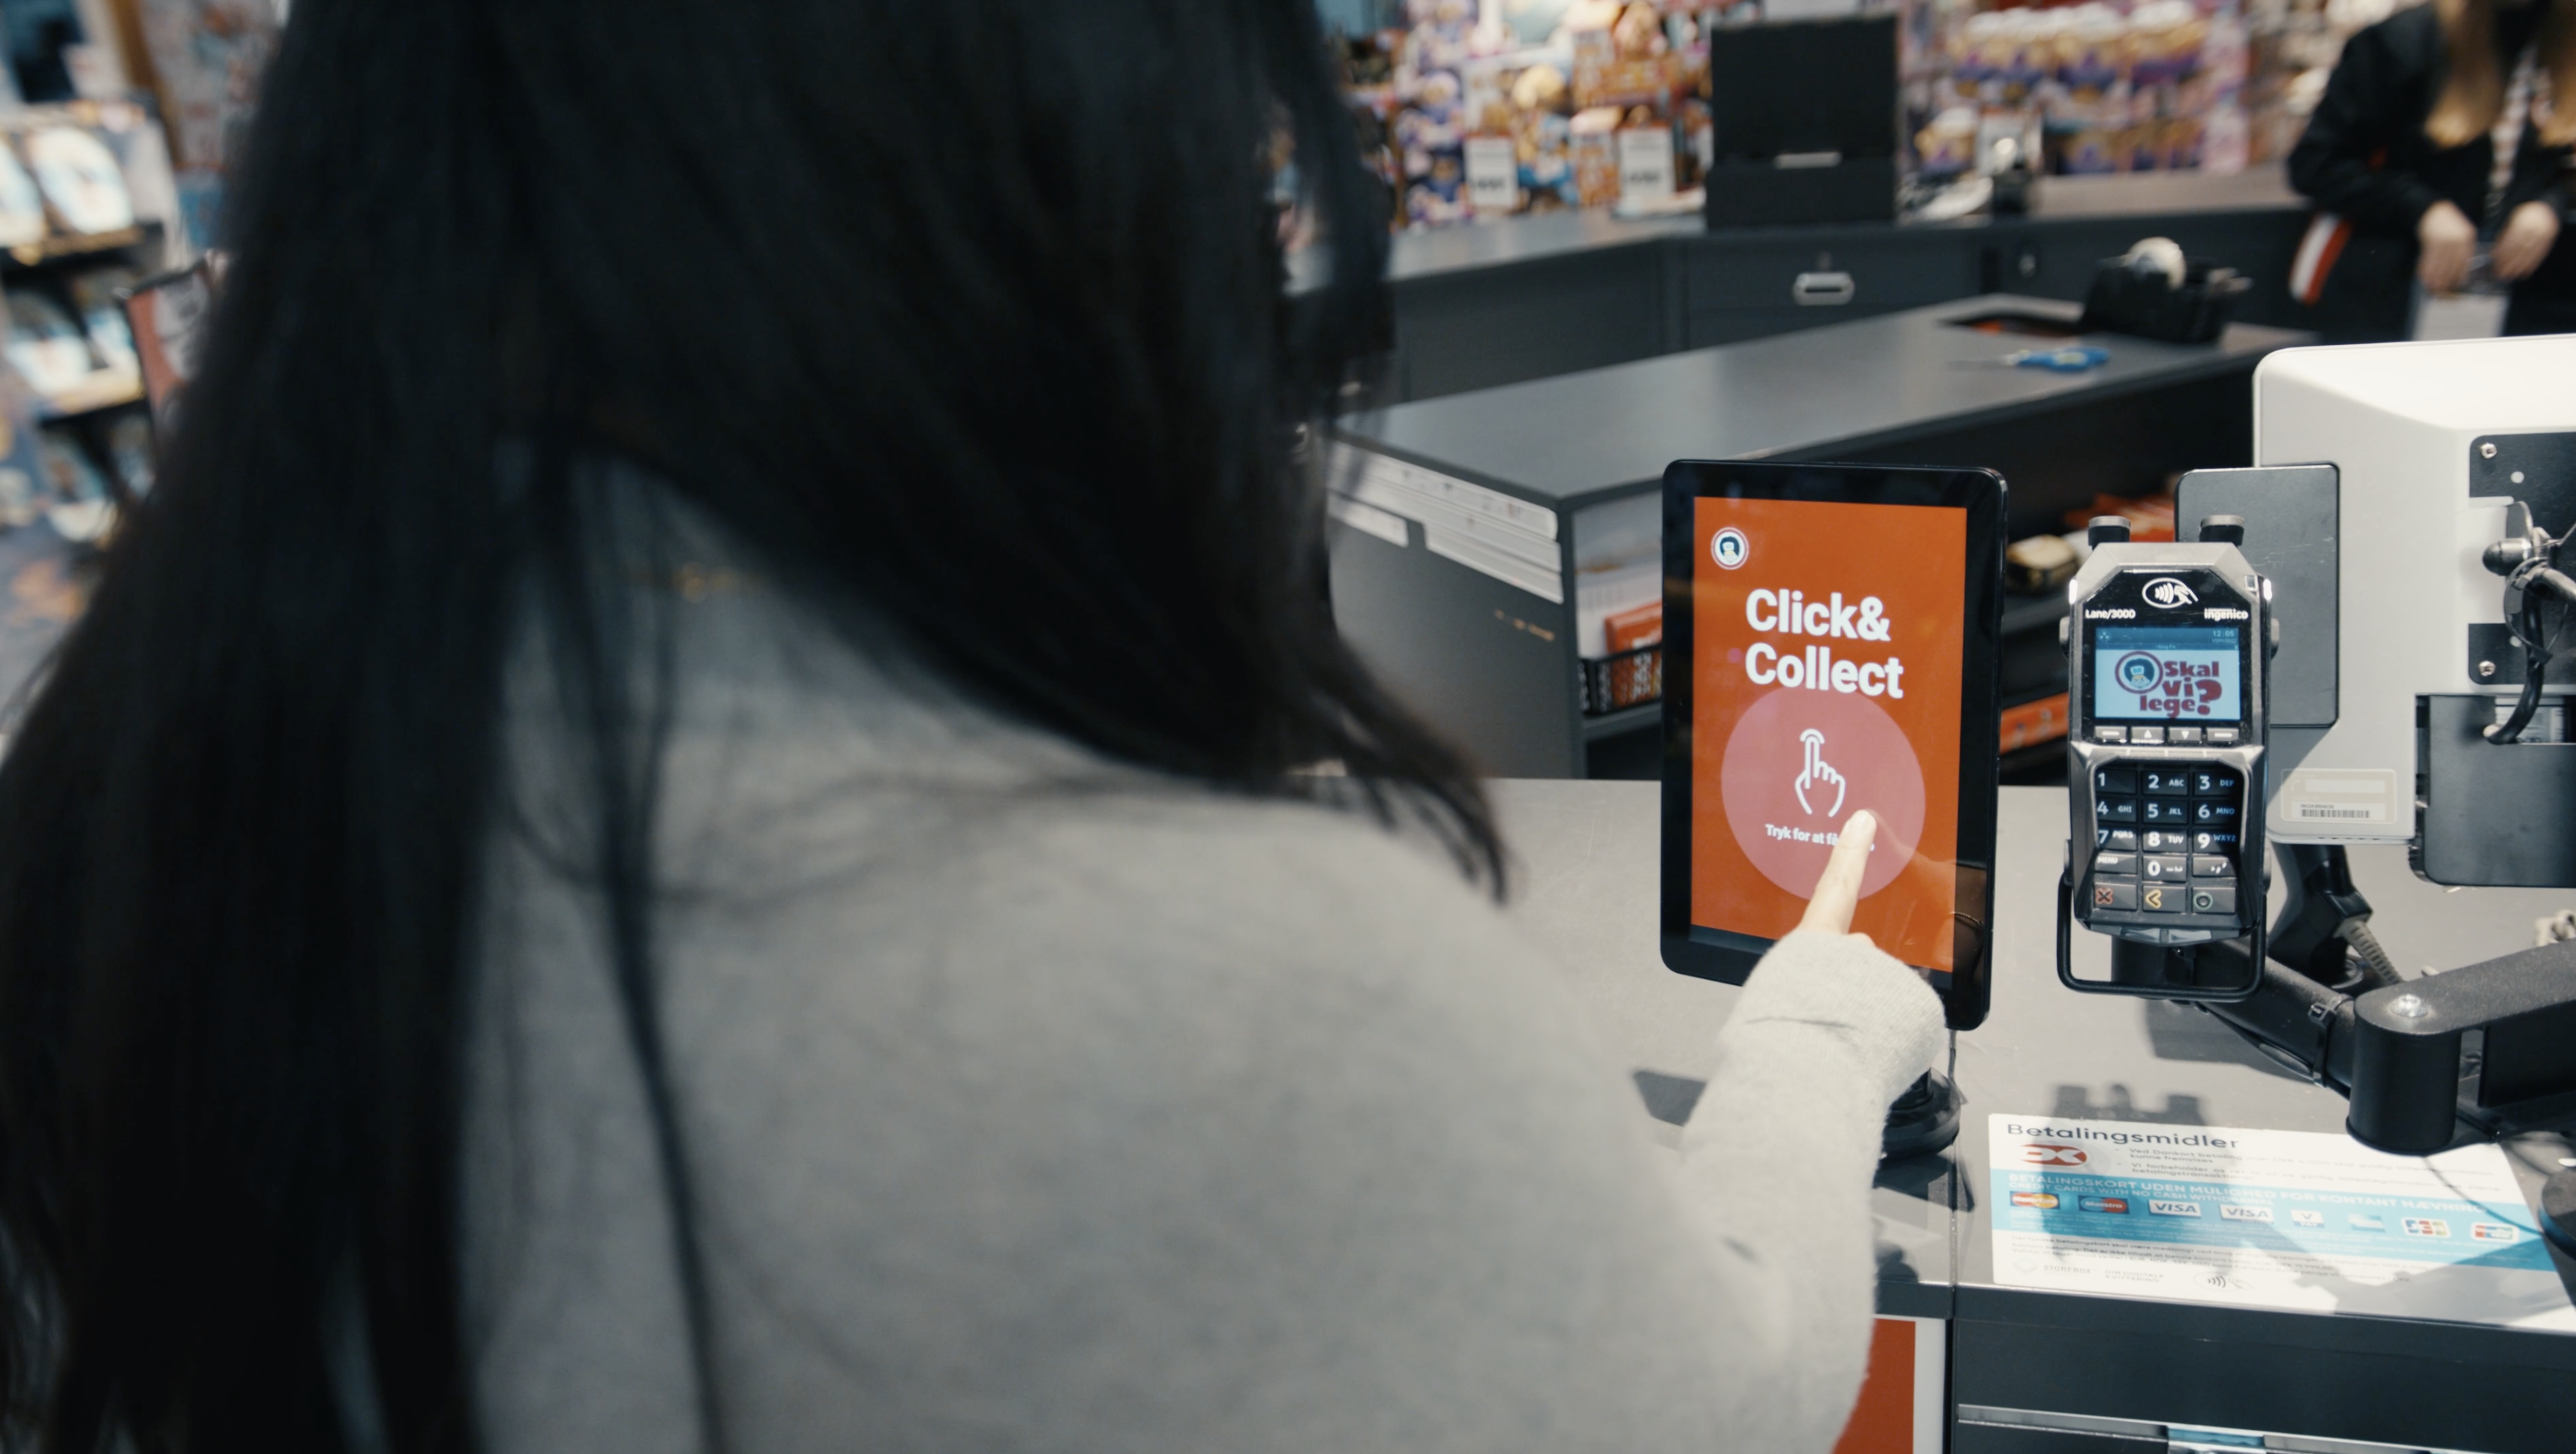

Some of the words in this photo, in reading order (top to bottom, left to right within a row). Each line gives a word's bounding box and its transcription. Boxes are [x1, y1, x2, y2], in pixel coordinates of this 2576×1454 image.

[1746, 588, 1891, 641] Click&
[2085, 608, 2136, 620] Lane/3000
[2204, 608, 2249, 621] ingenico
[1746, 642, 1904, 698] Collect
[2163, 661, 2220, 677] Skal
[2097, 773, 2106, 786] 1
[2148, 774, 2160, 789] 2
[2169, 779, 2184, 787] ABC
[2199, 775, 2211, 790] 3
[2097, 801, 2109, 815] 4
[2148, 804, 2159, 818] 5
[2198, 804, 2211, 819] 6
[1764, 823, 1791, 840] Tryk
[1792, 827, 1811, 842] for
[1812, 832, 1824, 844] at
[2097, 830, 2109, 844] 7
[2112, 831, 2133, 839] PQRS
[2148, 831, 2160, 846] 8
[2167, 836, 2184, 844] TUV
[2197, 834, 2211, 849] 9
[2214, 834, 2236, 843] WXYZ
[2097, 856, 2118, 864] MENU
[2148, 861, 2160, 876] 0
[2007, 1124, 2239, 1149] Betalingsmidler
[2008, 1173, 2137, 1189] BETALINGSKORT
[2141, 1182, 2186, 1193] UDEN
[2190, 1185, 2277, 1199] MULIGHED
[2280, 1191, 2316, 1201] FOR
[2319, 1194, 2397, 1207] KONTANT
[2008, 1182, 2052, 1191] CREDIT
[2054, 1185, 2096, 1194] CARDS
[2153, 1191, 2187, 1200] CASH
[2189, 1194, 2274, 1206] WITHDRAWAL
[2085, 1200, 2123, 1209] Maestro
[2154, 1203, 2197, 1213] VISA
[2225, 1208, 2270, 1218] VISA
